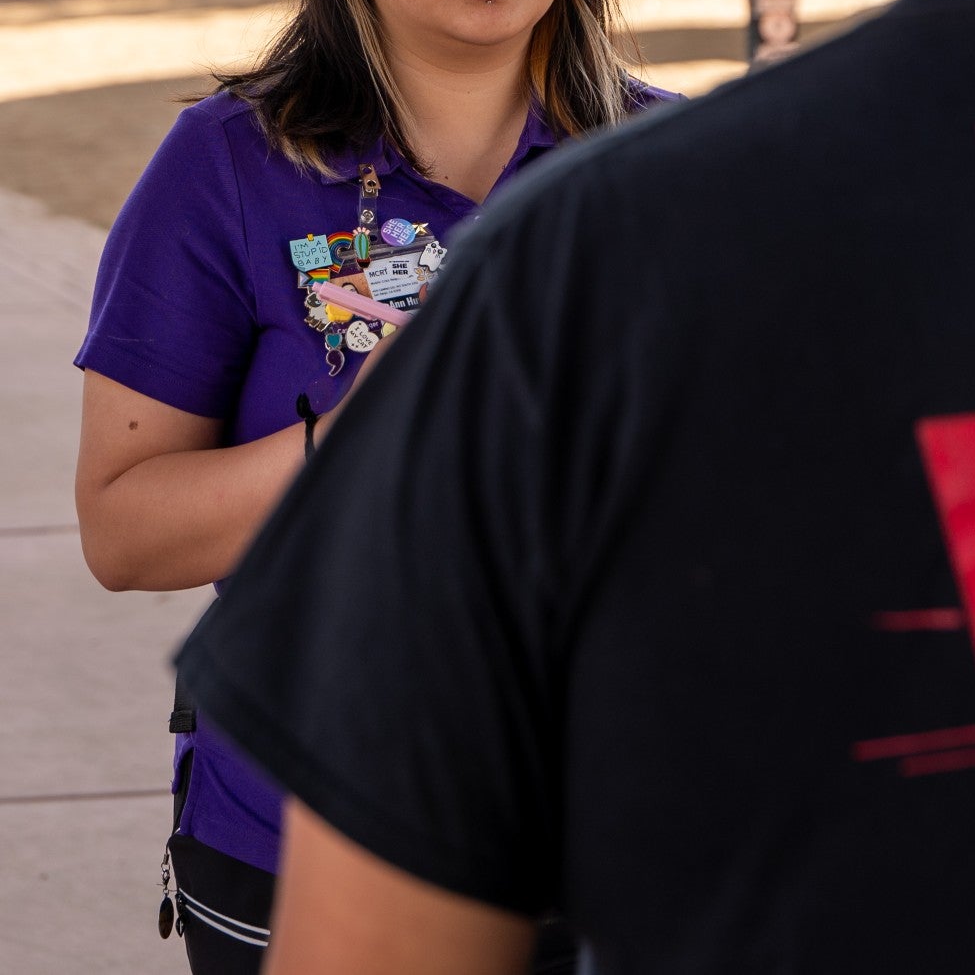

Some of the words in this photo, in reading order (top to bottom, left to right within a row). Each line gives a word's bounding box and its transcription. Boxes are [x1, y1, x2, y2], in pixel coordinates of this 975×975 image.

[383, 219, 398, 234] SHE
[391, 222, 405, 238] HER
[293, 246, 328, 259] STUPID
[297, 255, 327, 266] BABY
[368, 268, 388, 278] MCRT
[357, 338, 368, 348] CAT
[359, 331, 374, 345] LOVE
